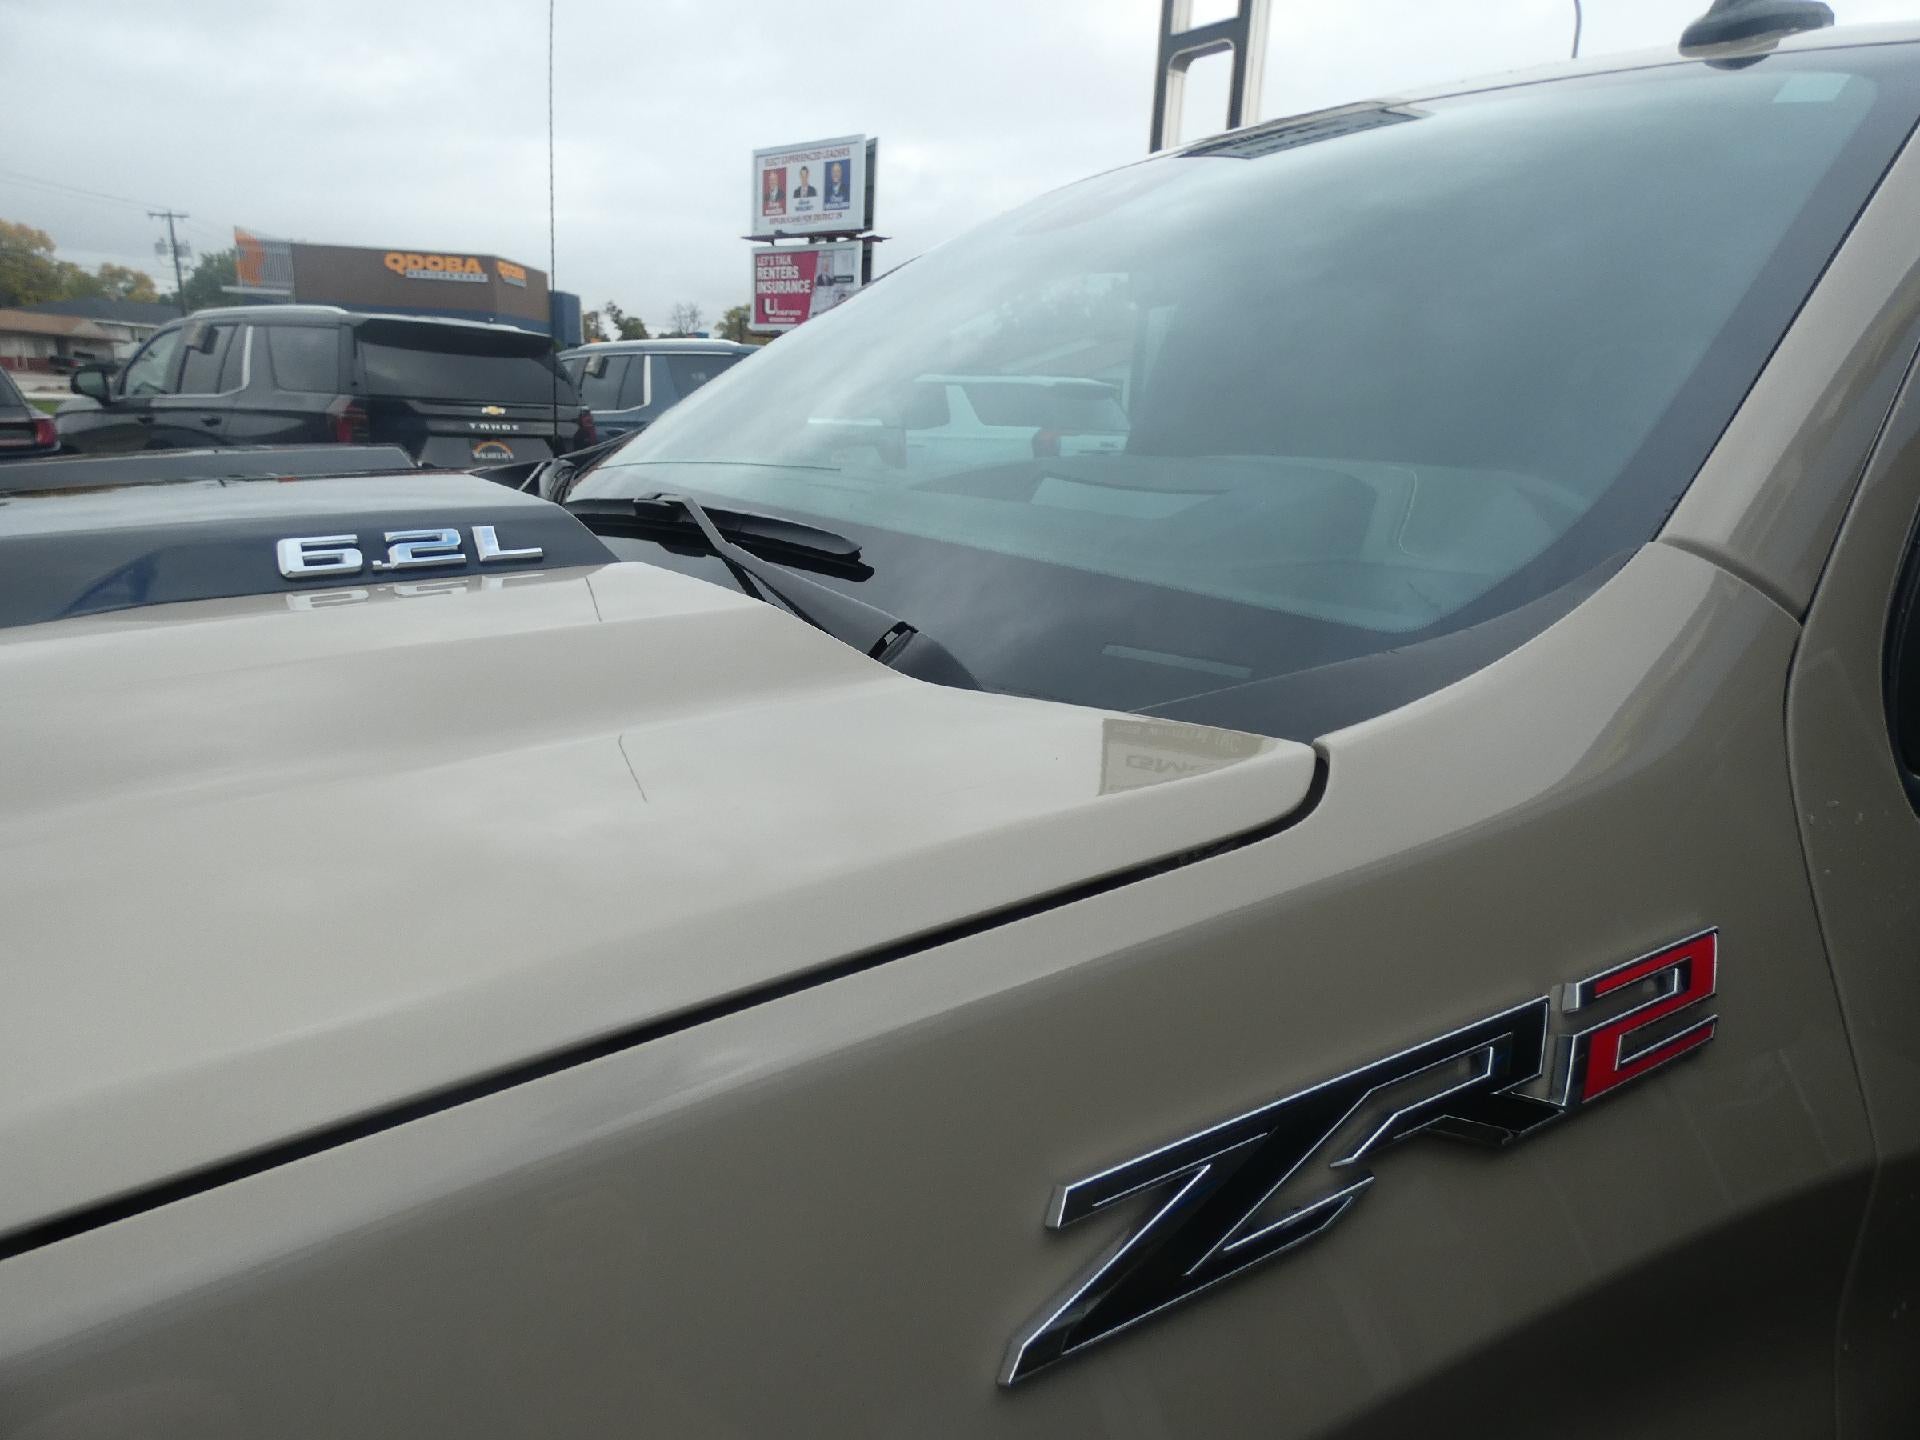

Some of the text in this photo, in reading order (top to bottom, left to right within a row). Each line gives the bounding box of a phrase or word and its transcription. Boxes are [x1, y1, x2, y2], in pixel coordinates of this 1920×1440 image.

[384, 252, 484, 276] QDOBA
[757, 254, 792, 267] LET'S TALK
[757, 265, 800, 280] RENTERS
[757, 279, 811, 295] INSURANCE
[277, 525, 544, 579] 6.2L
[998, 926, 1719, 1385] ZR2
